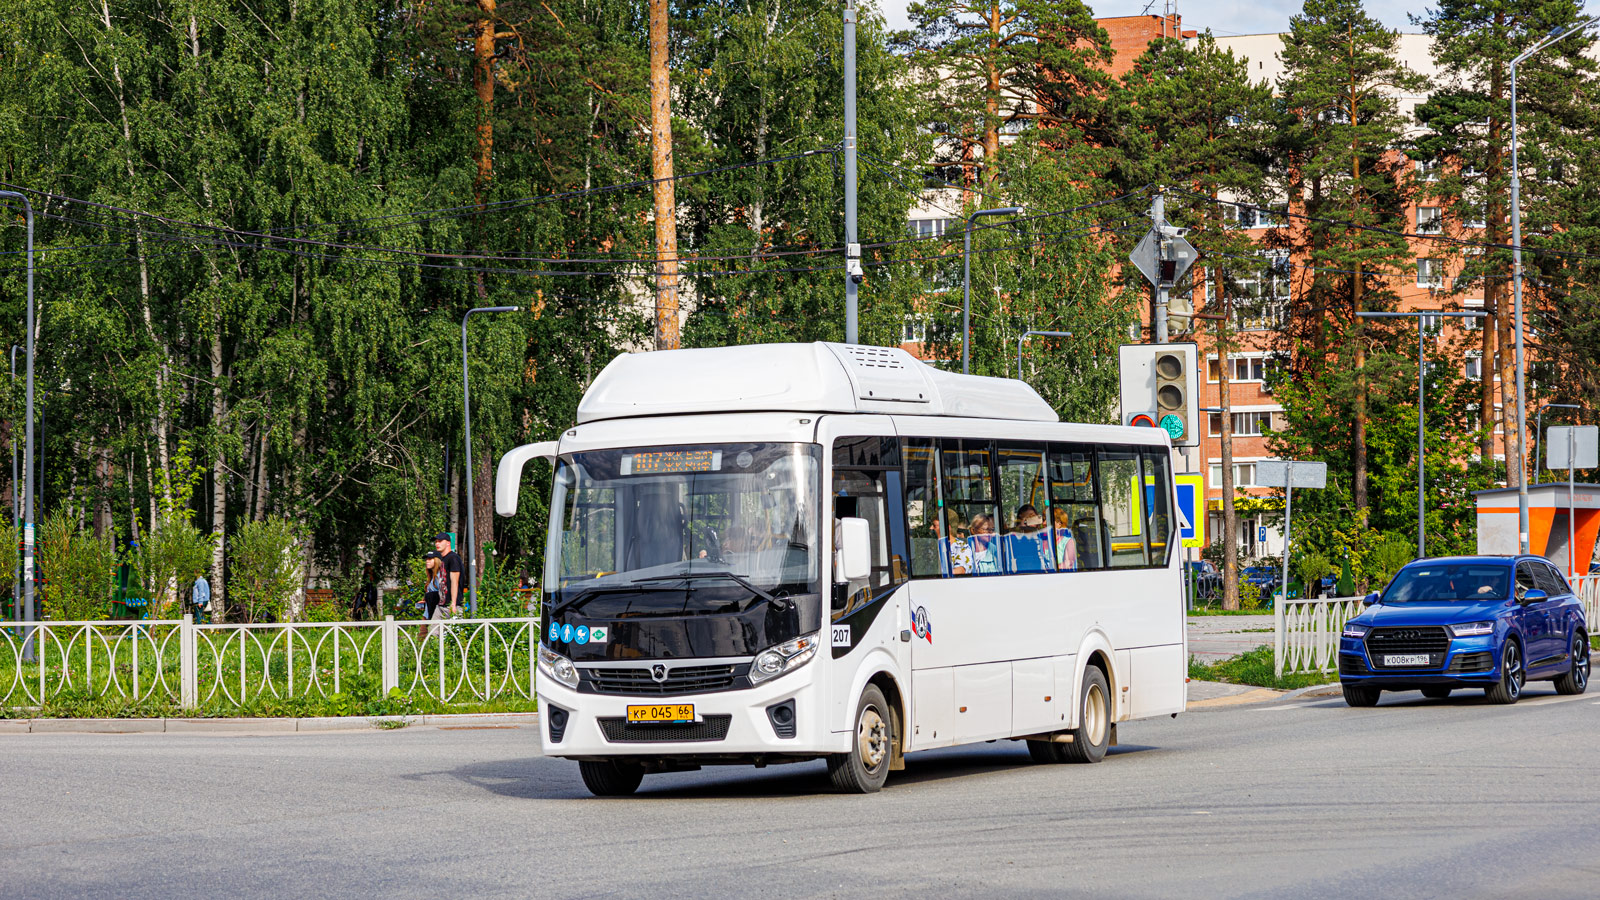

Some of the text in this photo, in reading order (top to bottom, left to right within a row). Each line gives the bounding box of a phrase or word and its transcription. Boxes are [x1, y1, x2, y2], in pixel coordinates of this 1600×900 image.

[633, 452, 662, 472] 107
[1260, 528, 1266, 541] P
[833, 629, 849, 643] 207
[633, 705, 690, 719] КР 045 66
